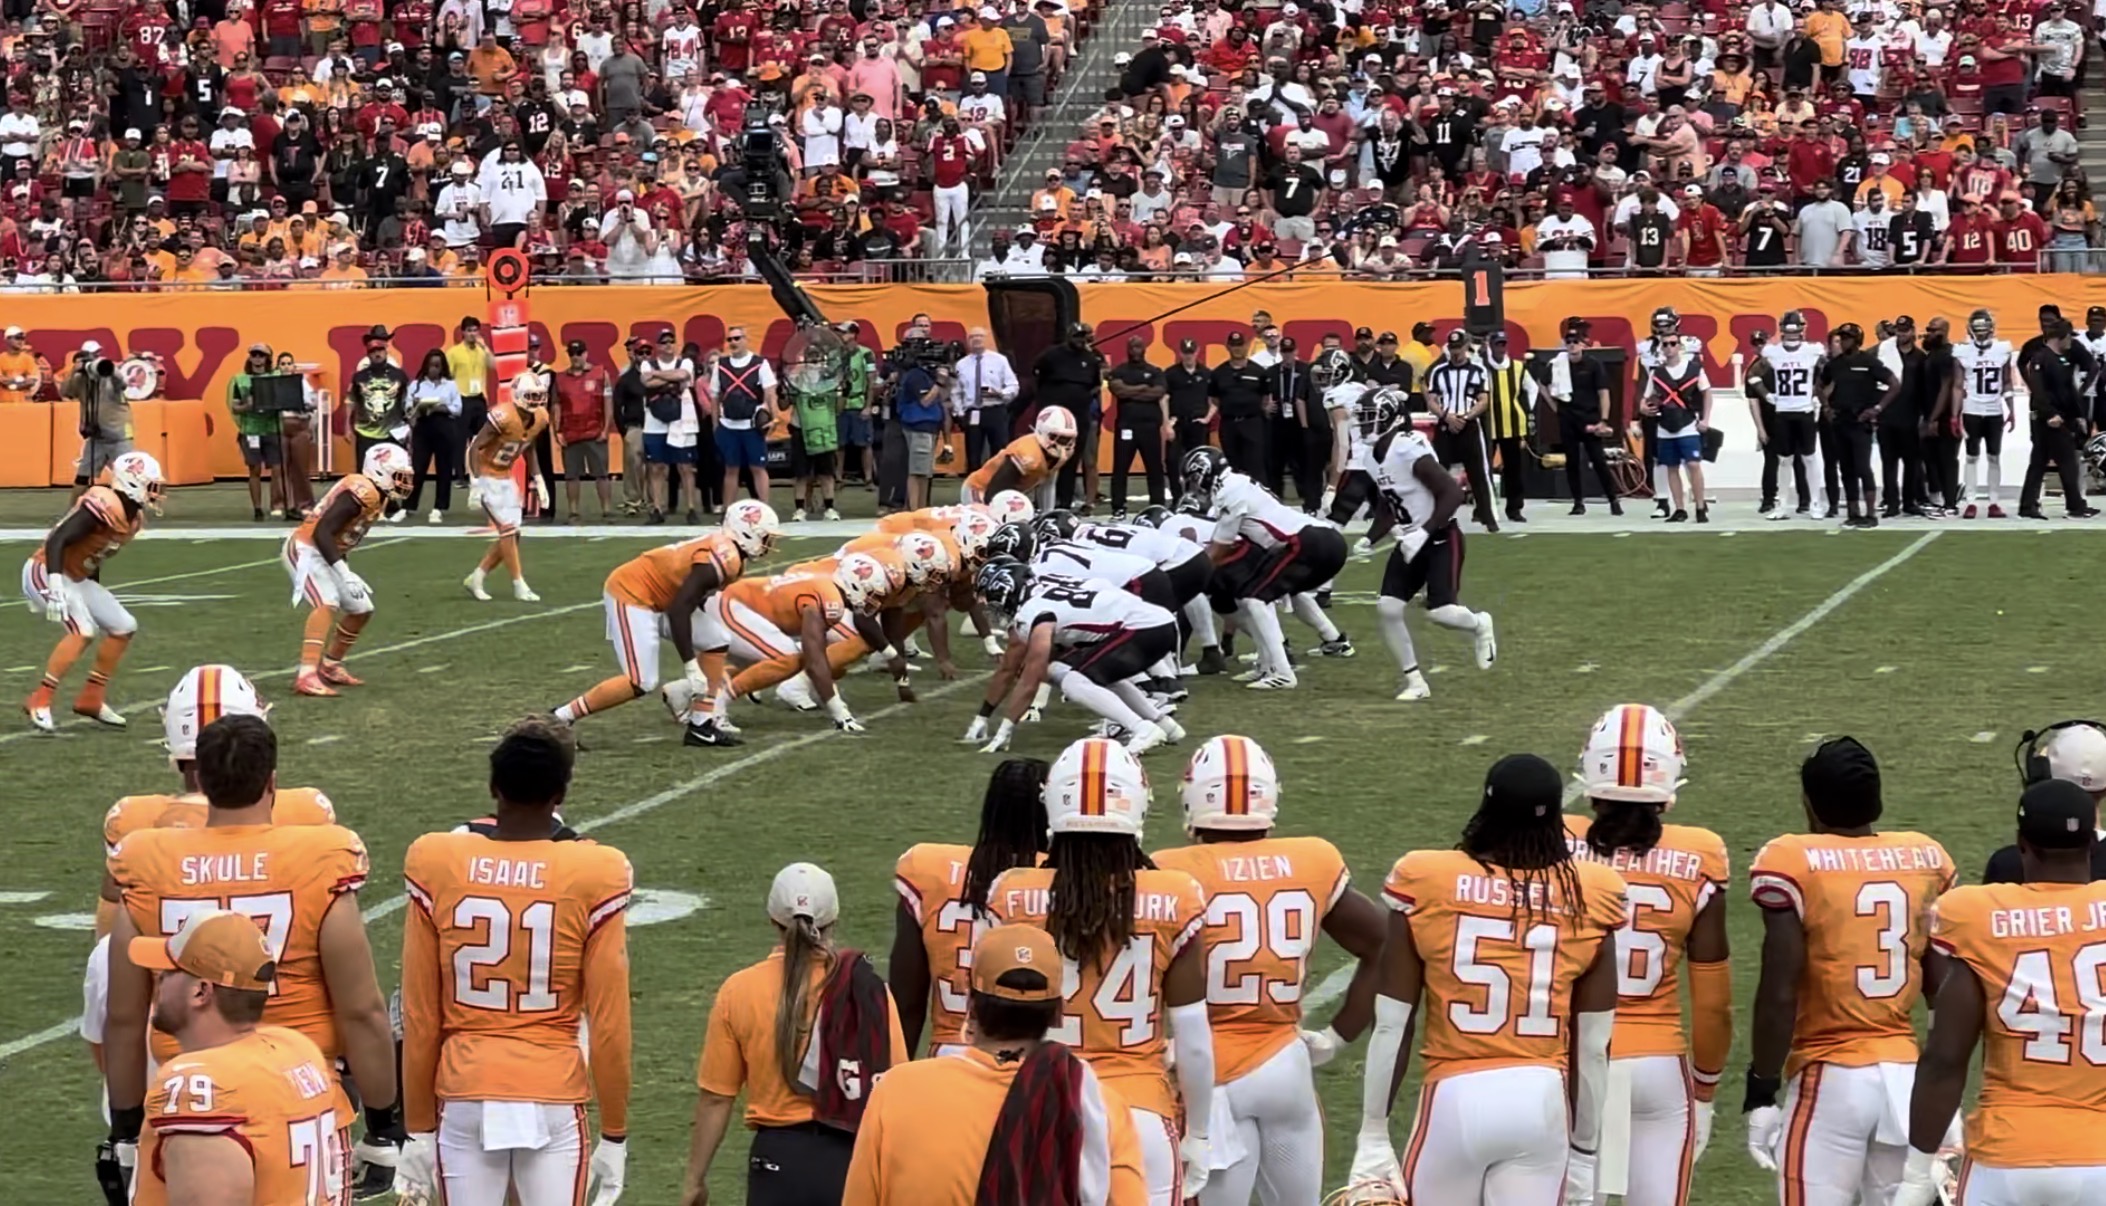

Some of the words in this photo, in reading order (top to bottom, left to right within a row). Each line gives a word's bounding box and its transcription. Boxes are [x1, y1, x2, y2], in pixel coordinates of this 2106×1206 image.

[139, 26, 165, 45] 87
[2014, 15, 2033, 31] 13
[197, 79, 213, 103] 5
[528, 112, 552, 134] 12
[1436, 121, 1452, 145] 11
[375, 166, 390, 189] 7
[1845, 165, 1864, 184] 21
[1283, 177, 1300, 199] 7
[1640, 227, 1660, 247] 13
[1757, 226, 1774, 251] 7
[1865, 228, 1888, 252] 18
[1902, 231, 1918, 257] 5
[1962, 232, 1982, 250] 12
[2006, 228, 2033, 253] 40
[1473, 271, 1490, 306] 1
[1776, 368, 1807, 397] 82
[1973, 367, 2000, 395] 12
[181, 852, 269, 886] SKULE
[1221, 855, 1292, 882] IZIEN
[1803, 845, 1944, 873] WHITEHEAD
[468, 856, 547, 890] ISAAC
[1990, 905, 2075, 939] GRIER
[1206, 888, 1317, 1006] 29
[1854, 879, 1909, 1000] 3
[452, 896, 559, 1014] 21
[1449, 913, 1560, 1038] 51
[162, 1074, 214, 1115] 79
